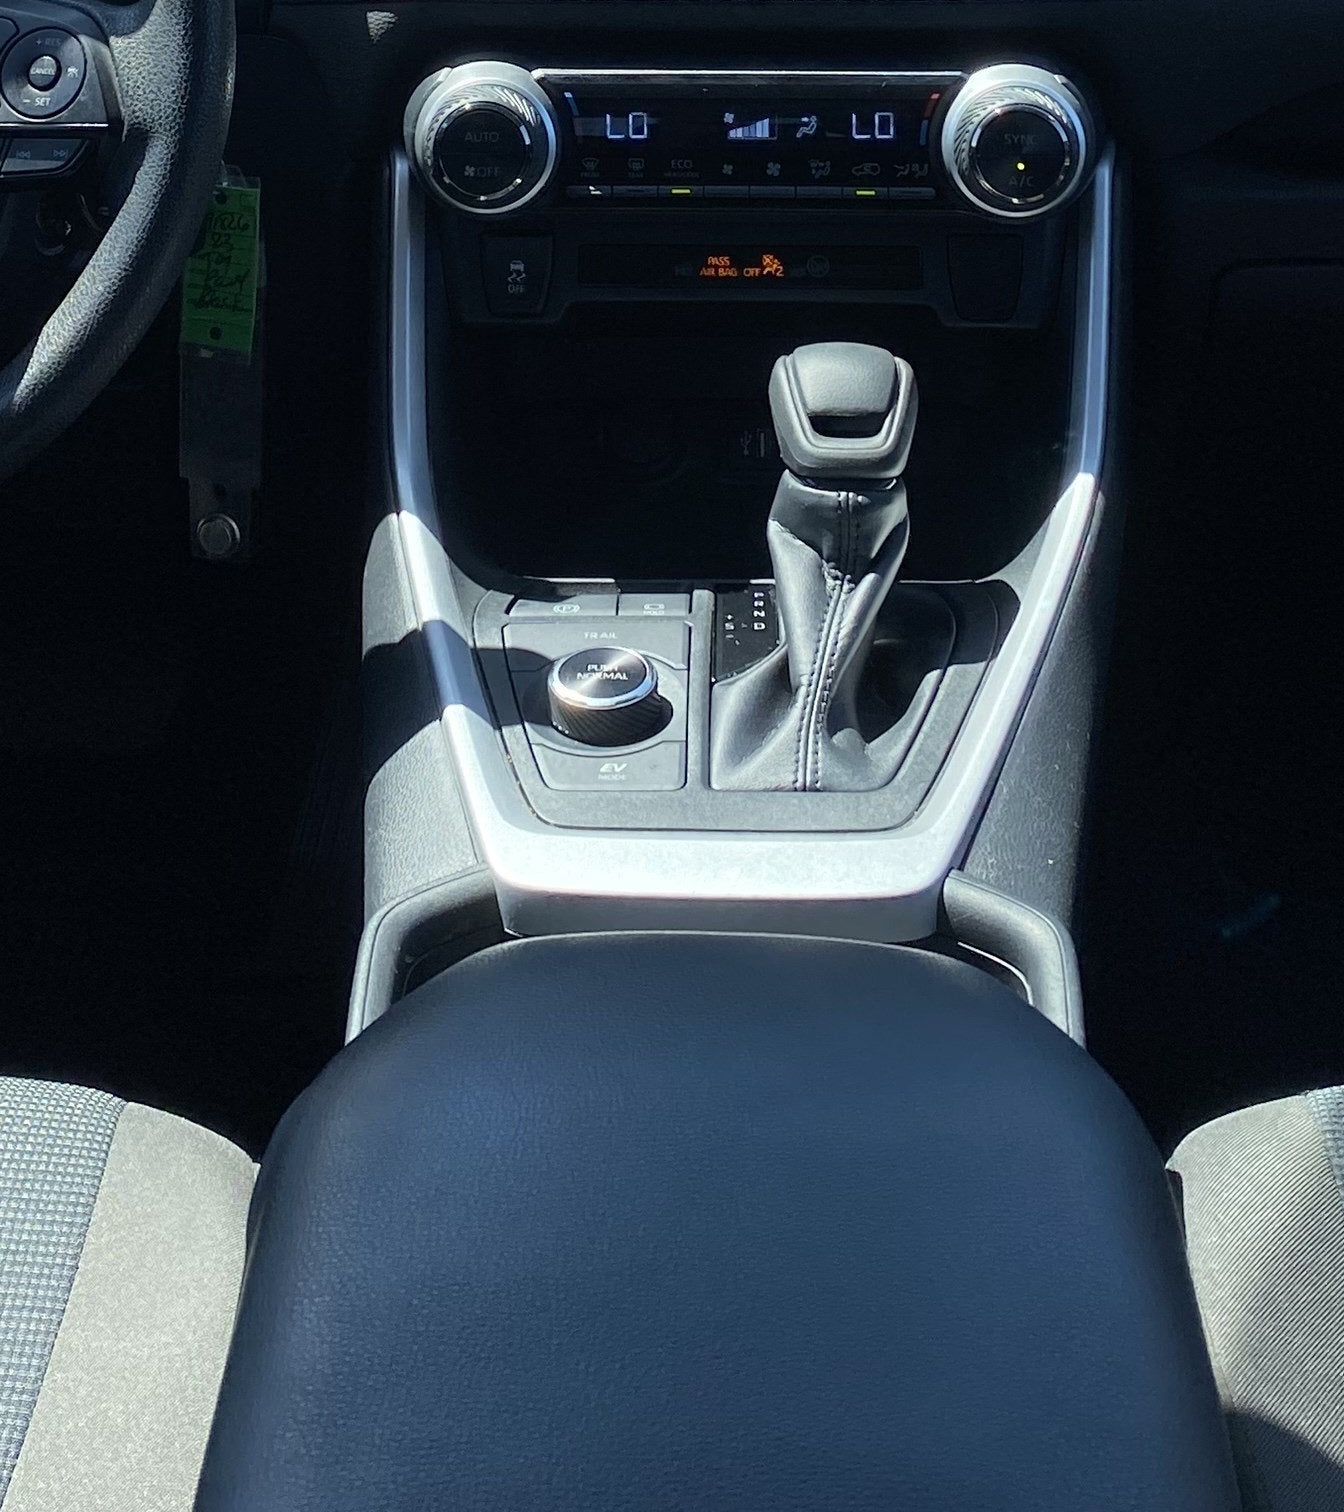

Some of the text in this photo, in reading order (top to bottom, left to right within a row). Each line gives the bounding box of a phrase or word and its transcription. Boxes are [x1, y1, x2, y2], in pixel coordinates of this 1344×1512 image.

[31, 67, 55, 75] CANCEL
[35, 97, 51, 107] SET
[464, 131, 500, 143] AUTO
[1004, 133, 1037, 145] SYNC
[670, 159, 694, 169] ECO
[1007, 175, 1035, 186] A/C
[707, 256, 731, 266] PASS
[699, 267, 715, 277] AIR
[718, 267, 737, 277] BAG
[743, 267, 761, 277] OFF
[583, 631, 618, 639] TRAIL
[576, 672, 629, 681] NORMAL
[599, 763, 628, 773] EV
